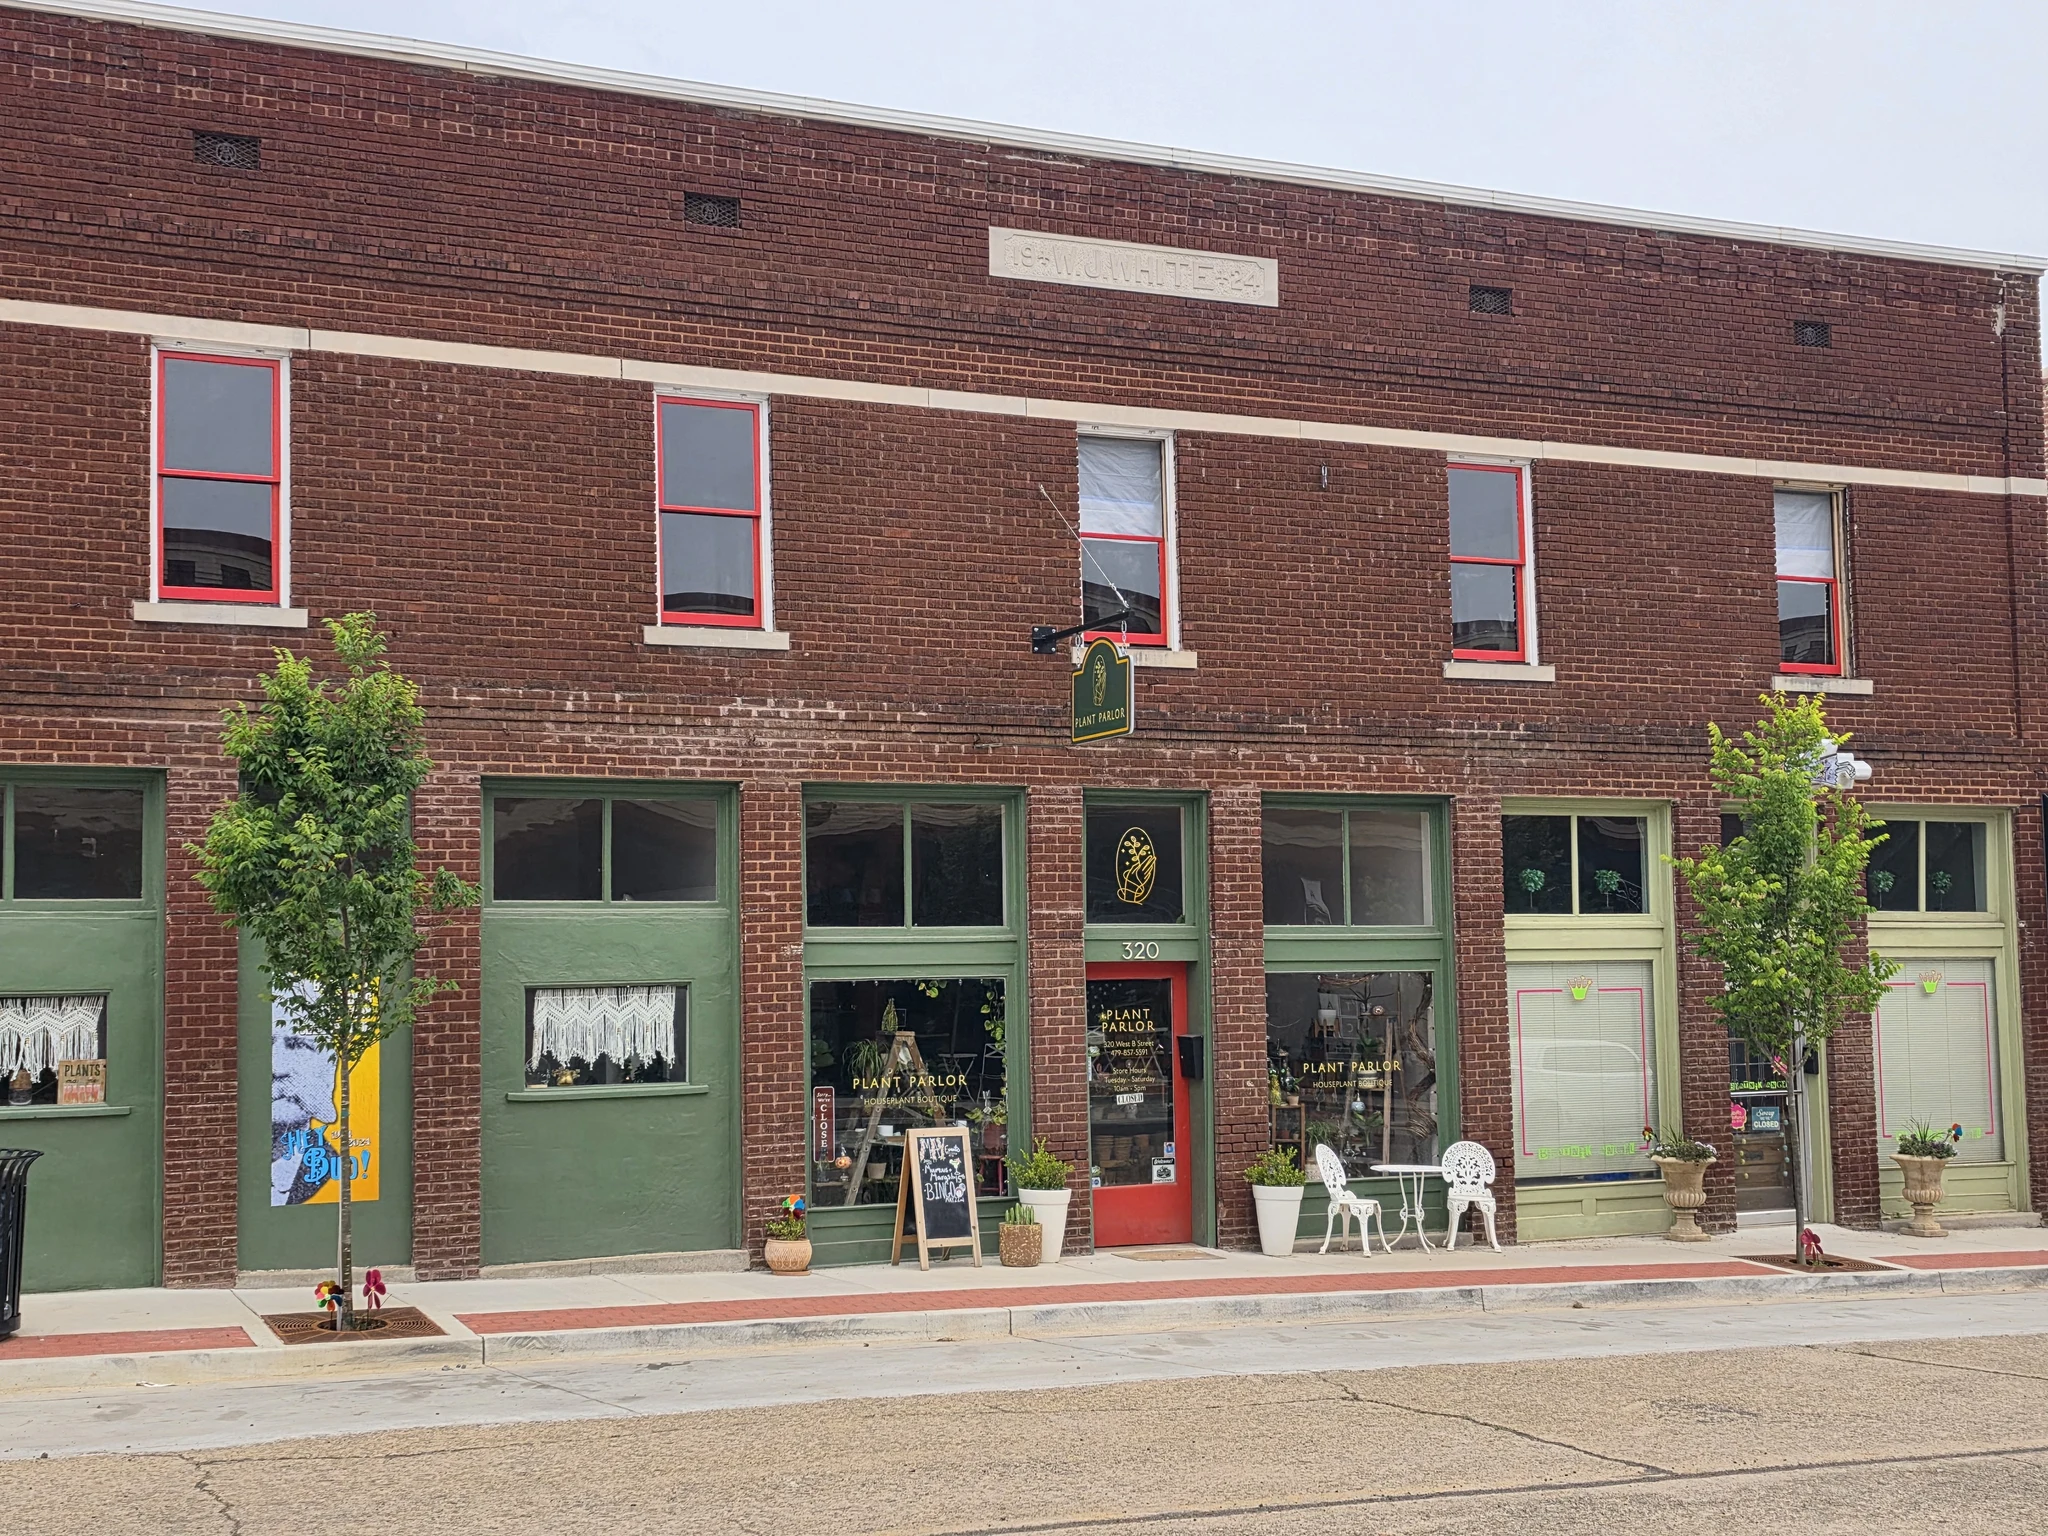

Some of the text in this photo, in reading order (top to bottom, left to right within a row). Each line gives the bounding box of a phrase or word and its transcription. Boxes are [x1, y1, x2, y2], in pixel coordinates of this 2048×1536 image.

[1013, 243, 1035, 268] 19
[1230, 268, 1261, 293] 24
[1075, 707, 1125, 728] PLANT PARLOR
[1122, 942, 1159, 959] 320
[1106, 1008, 1150, 1020] PLANT
[1102, 1020, 1155, 1032] PARLOR
[64, 1064, 101, 1077] PLANTS
[1130, 1066, 1147, 1074] Hours
[1303, 1060, 1401, 1073] PLANT PARLOR
[853, 1074, 967, 1089] PLANT PARLOR
[1104, 1076, 1127, 1084] Tuesday
[1131, 1075, 1156, 1083] Saturday
[1312, 1079, 1393, 1088] HOUSEPLANT BOUTIQUE
[1133, 1084, 1147, 1092] 5pm
[864, 1095, 957, 1106] HOUSEPLANT BOUTIQUE
[1756, 1109, 1775, 1119] Sorry
[819, 1104, 829, 1148] CLOSE
